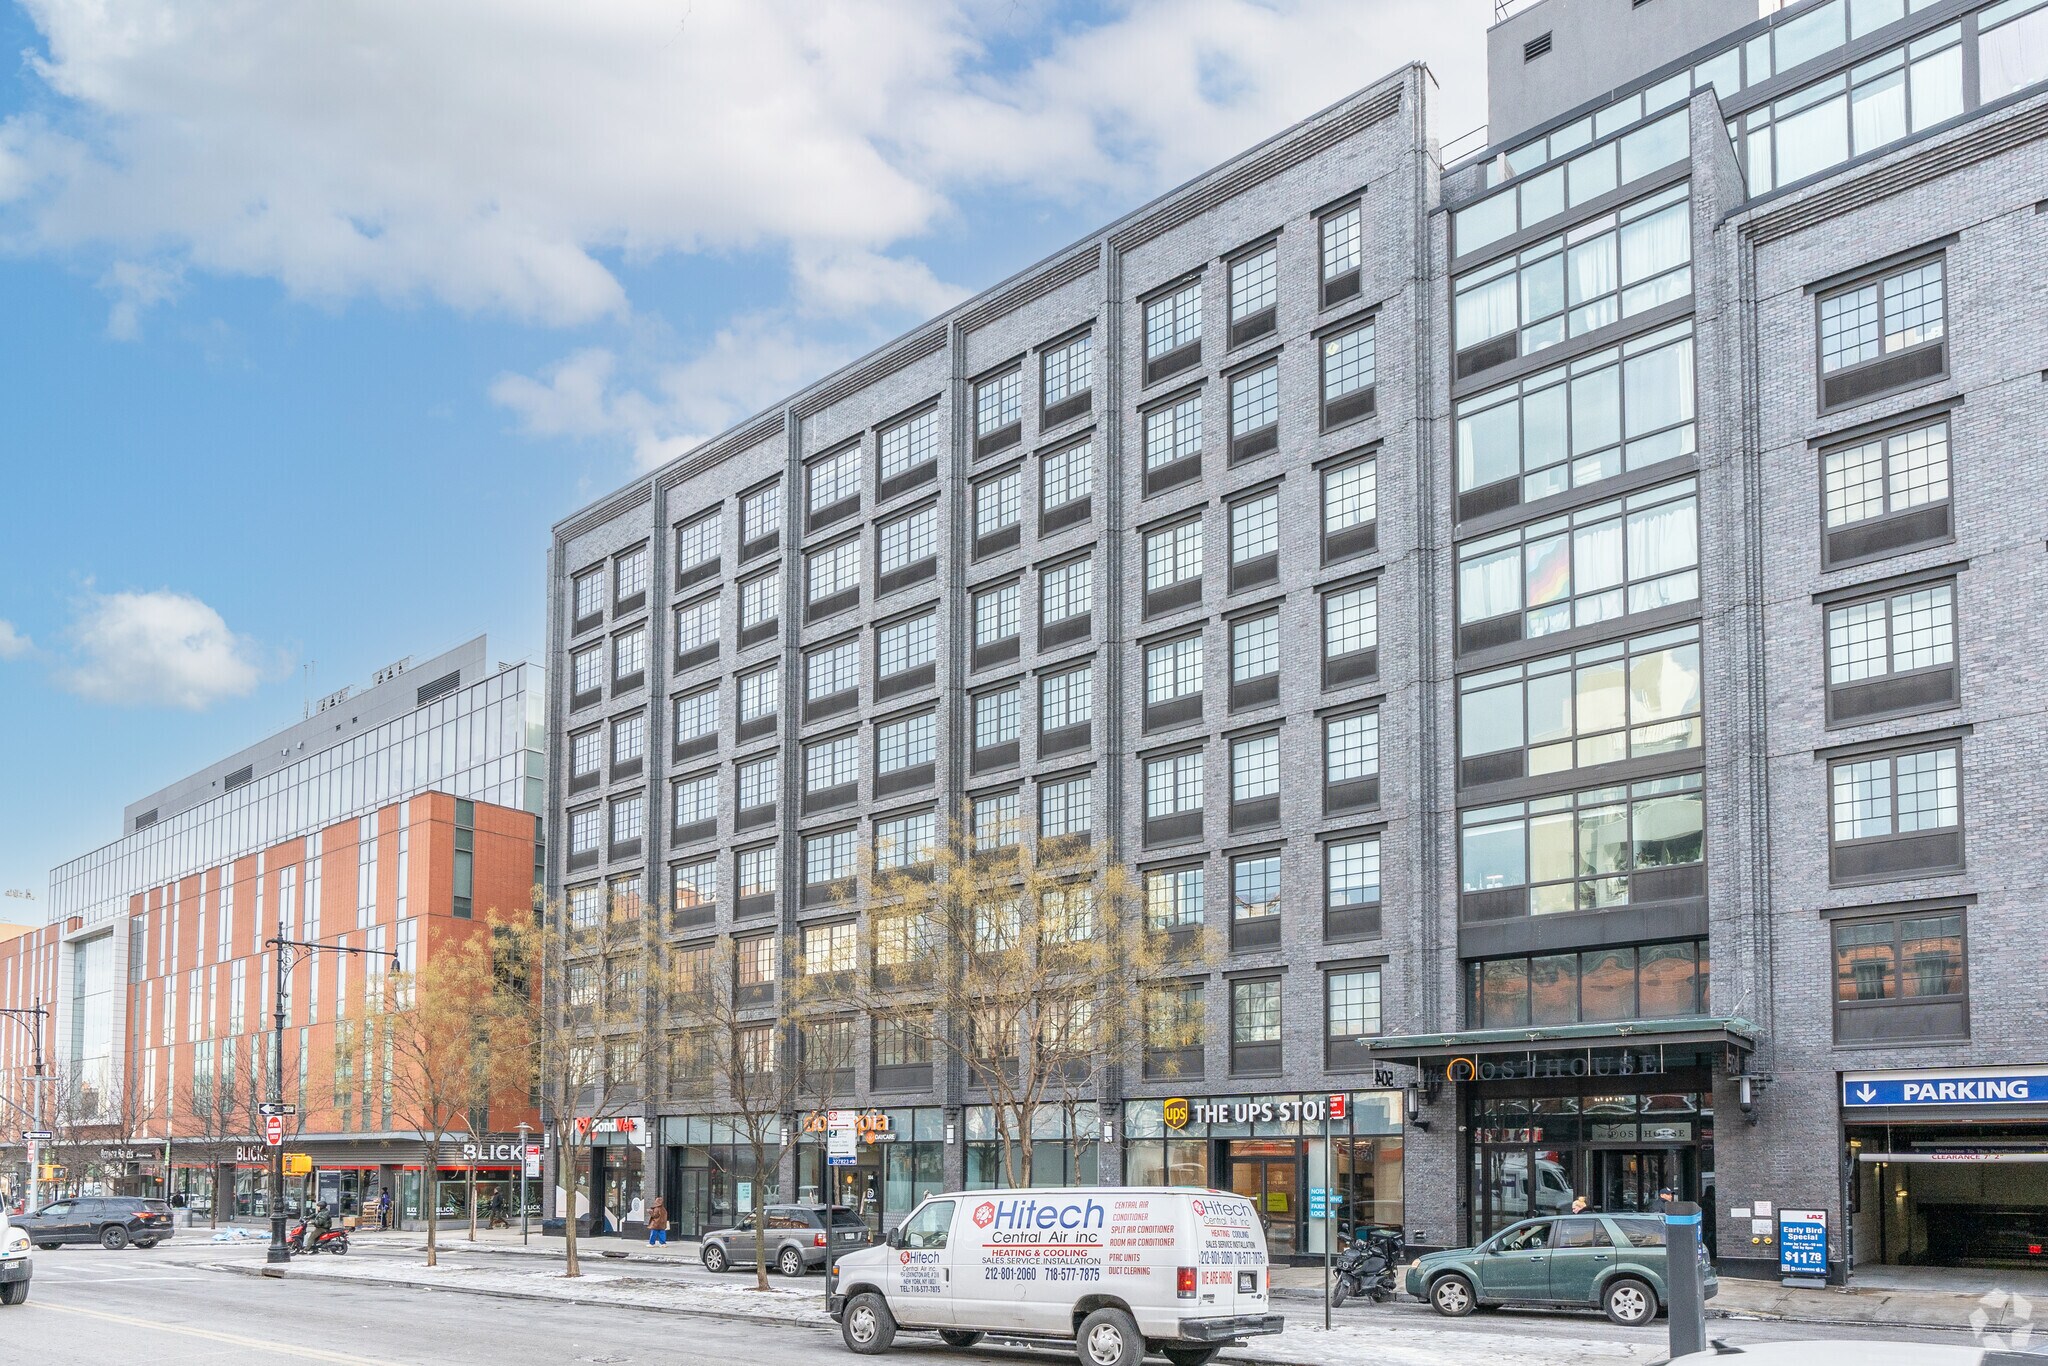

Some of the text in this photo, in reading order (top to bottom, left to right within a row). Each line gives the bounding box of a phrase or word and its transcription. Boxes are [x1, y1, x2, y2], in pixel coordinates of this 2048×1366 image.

[1454, 1054, 1657, 1081] POSTHOUSE
[1903, 1080, 2029, 1101] PARKING
[1166, 1106, 1187, 1125] ups
[1194, 1104, 1229, 1123] THE
[1234, 1102, 1274, 1122] UPS
[1279, 1100, 1328, 1121] STOR
[463, 1144, 523, 1160] BLICK
[1114, 1200, 1149, 1209] CENTRAL AIR
[1202, 1200, 1253, 1217] Hitech
[994, 1198, 1105, 1230] Hitech
[1112, 1213, 1149, 1221] CONDITIONER
[1110, 1225, 1175, 1234] SPLIT AIR CONDITIONER
[1783, 1226, 1804, 1234] Early
[992, 1230, 1098, 1243] Central Air inc
[1109, 1238, 1175, 1247] ROOM AIR CONDITIONER
[910, 1251, 940, 1264] Hitech
[992, 1249, 1088, 1257] HEATING & COOLING
[1124, 1254, 1141, 1262] UNITS
[985, 1267, 1100, 1281] 212-801-2060 718-577-7875
[1108, 1266, 1151, 1275] DUCT CLEANING
[1201, 1271, 1209, 1284] WE
[1209, 1271, 1218, 1284] ARE
[1219, 1271, 1232, 1284] HIRING
